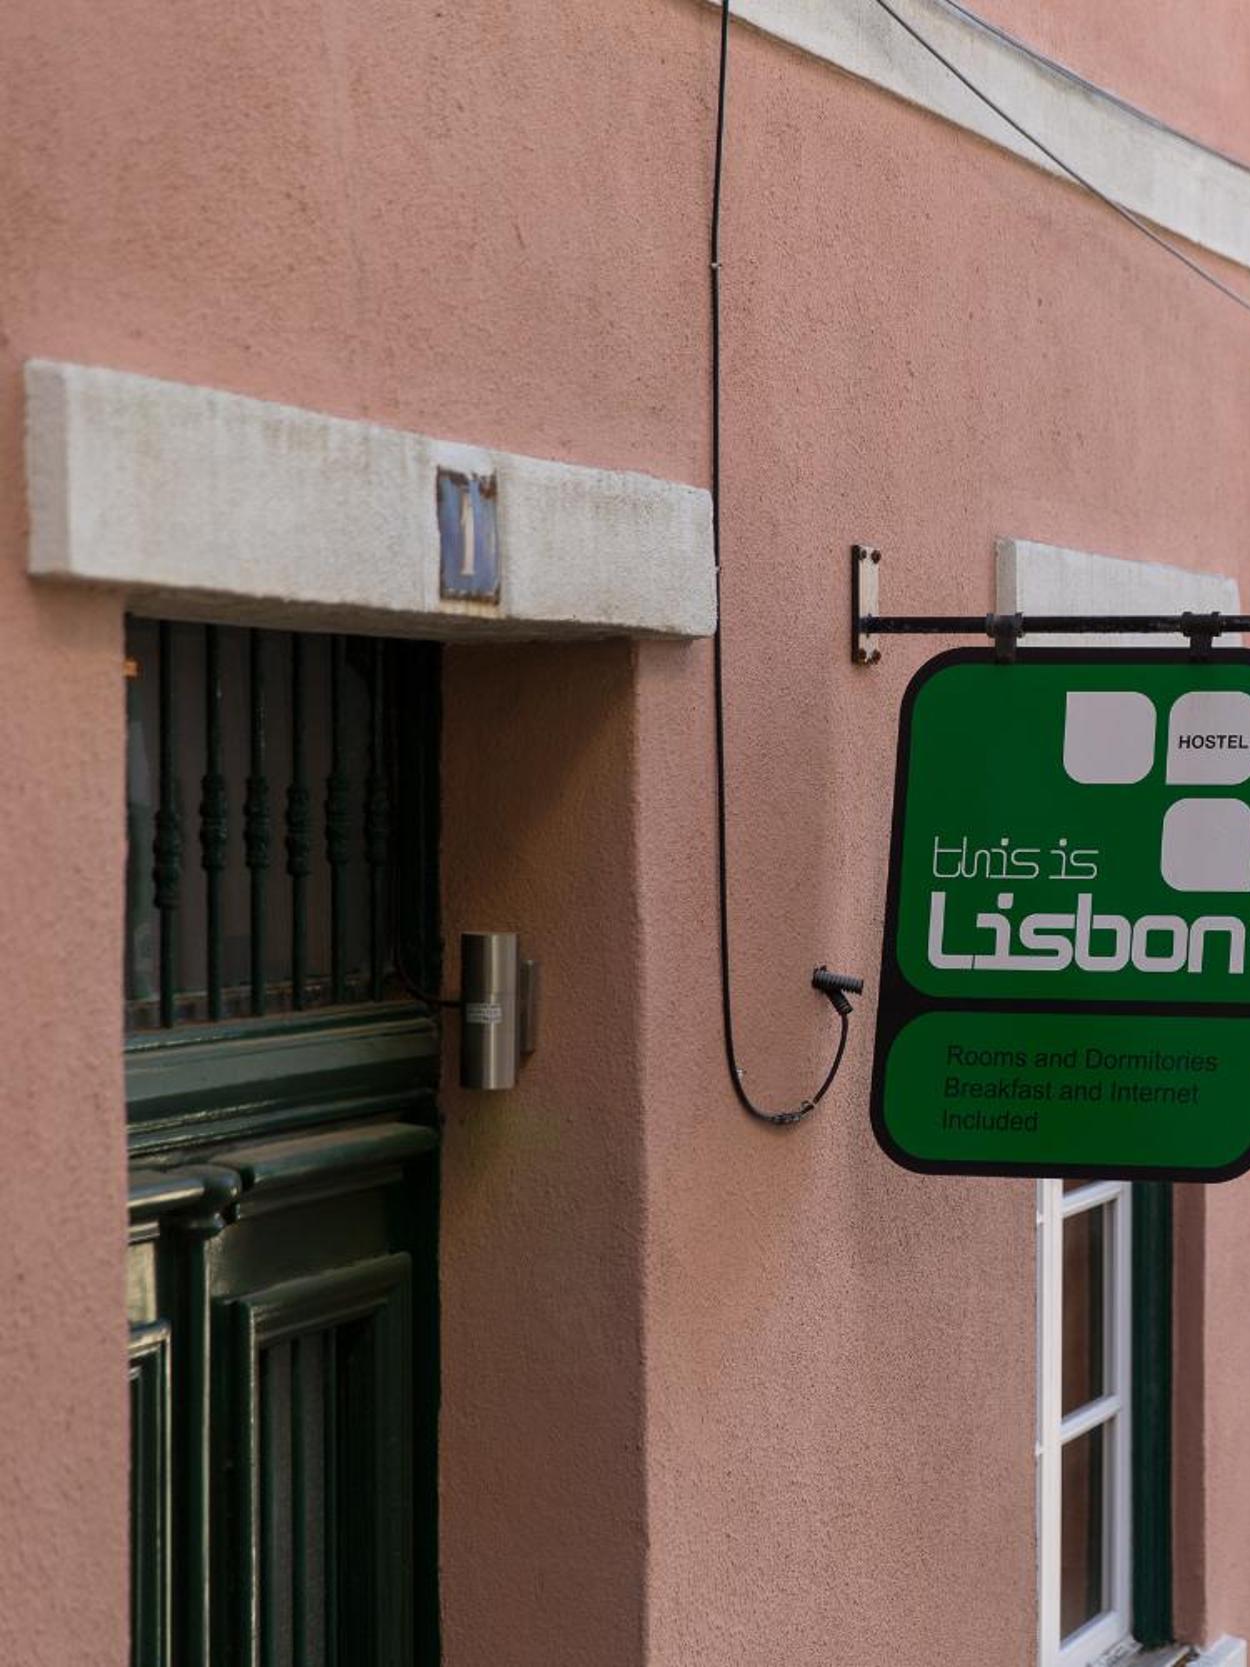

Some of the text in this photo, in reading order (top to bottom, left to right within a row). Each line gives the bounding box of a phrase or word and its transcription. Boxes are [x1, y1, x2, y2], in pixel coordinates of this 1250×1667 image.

[460, 489, 476, 575] 1
[1178, 734, 1248, 749] HOSTEL
[932, 835, 1099, 880] this is
[927, 891, 1246, 974] Lisbon
[946, 1045, 1217, 1072] Rooms and Dormitories
[944, 1077, 1199, 1104] Breakfast and Internet
[942, 1110, 1039, 1132] Included
